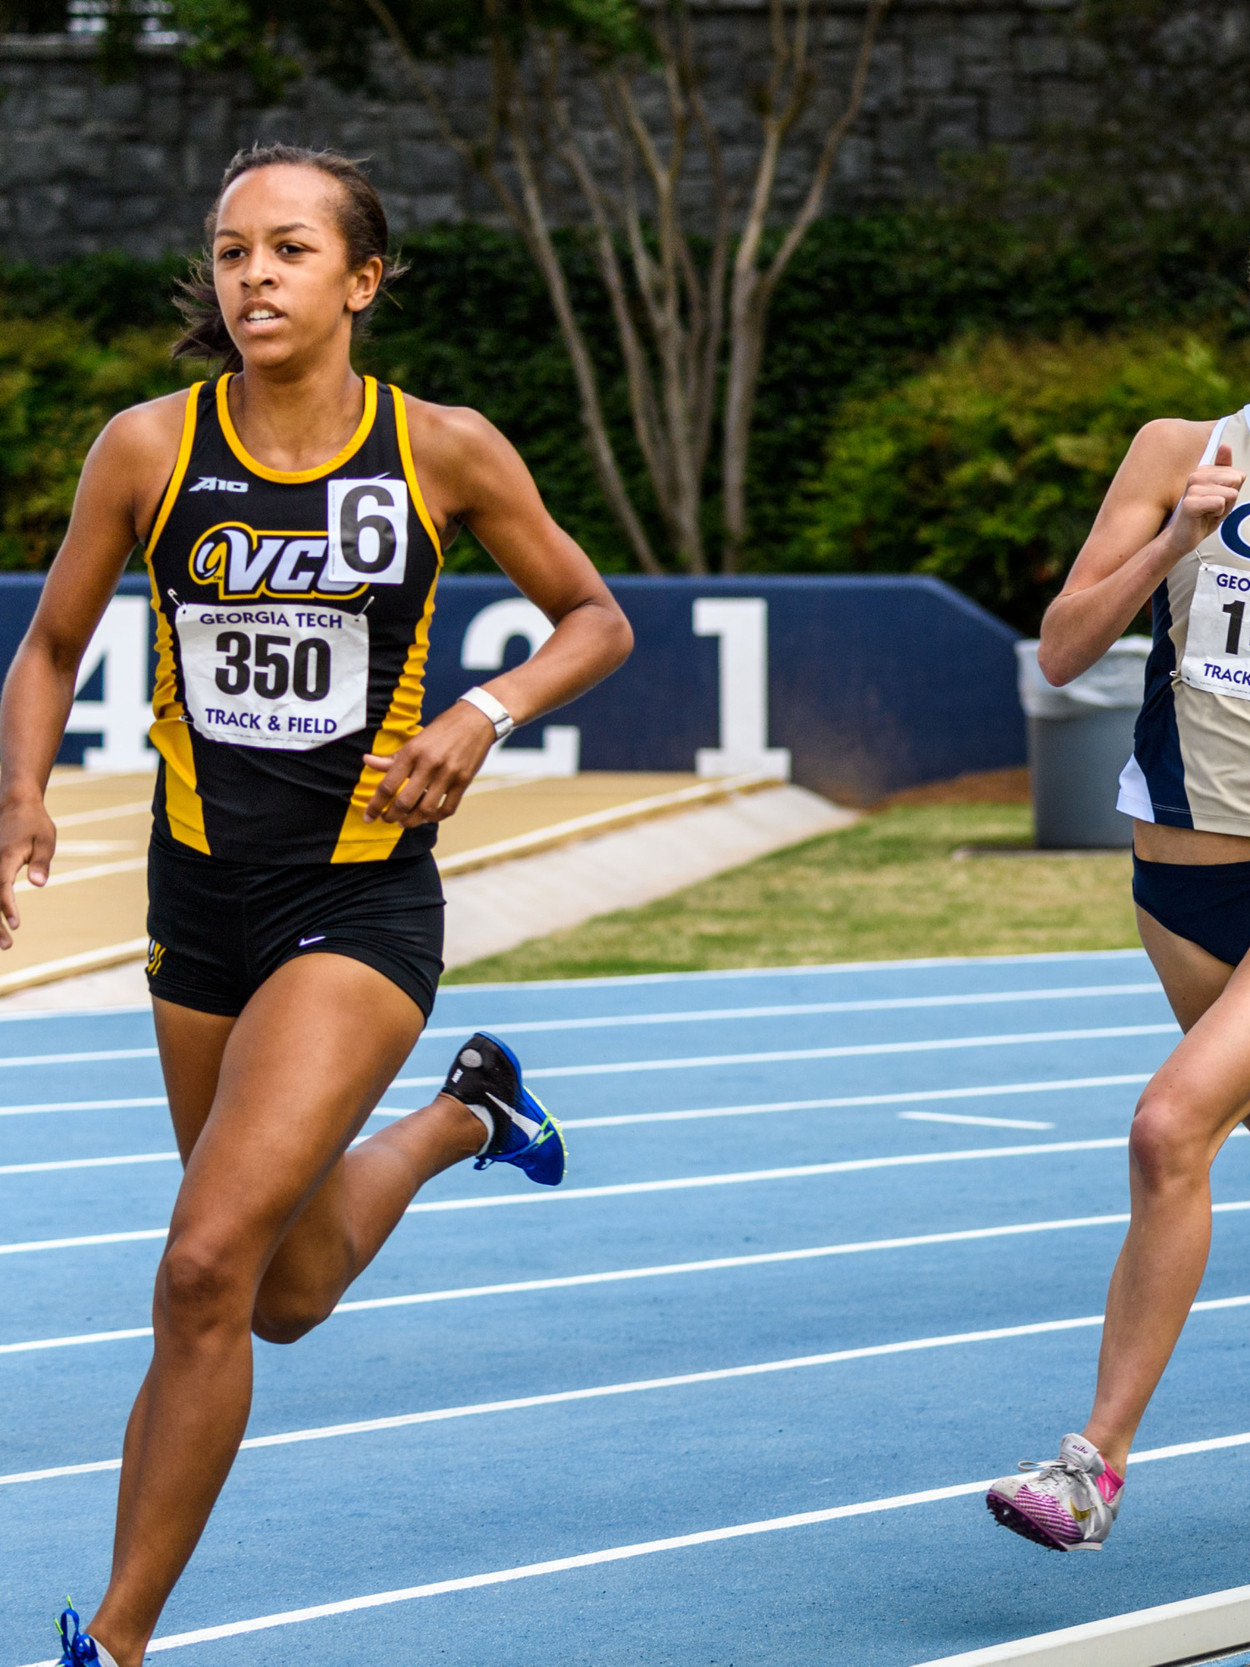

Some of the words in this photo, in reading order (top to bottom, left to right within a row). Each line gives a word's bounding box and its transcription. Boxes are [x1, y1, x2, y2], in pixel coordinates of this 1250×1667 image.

[189, 476, 249, 493] A10
[340, 484, 398, 574] 6
[200, 611, 290, 627] GEORGIA
[295, 612, 343, 630] TECH
[63, 595, 159, 771] 4
[461, 598, 580, 777] 2
[693, 598, 791, 780] 1
[215, 631, 332, 702] 350
[205, 708, 261, 730] TRACK
[268, 715, 281, 731] &
[288, 716, 338, 735] FIELD
